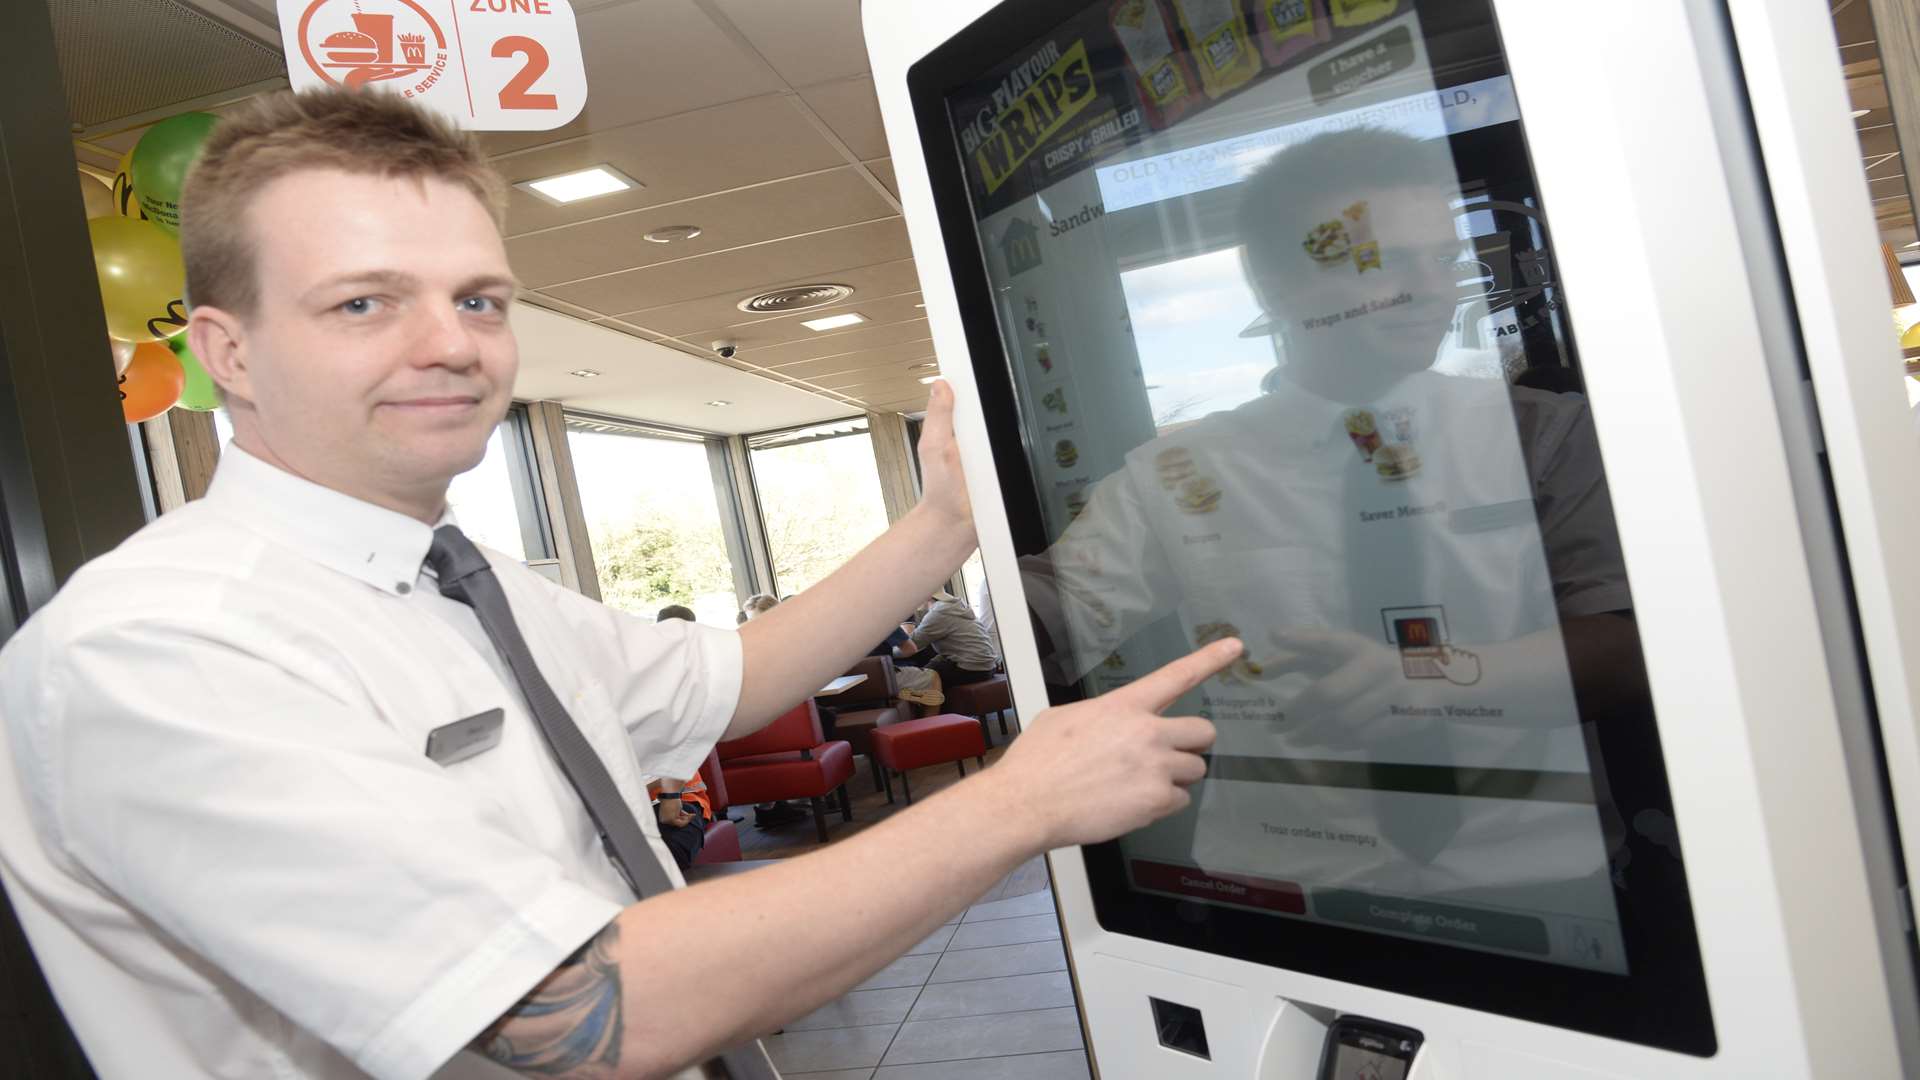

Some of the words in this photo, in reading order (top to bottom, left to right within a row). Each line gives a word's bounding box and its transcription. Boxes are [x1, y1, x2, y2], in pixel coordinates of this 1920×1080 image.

[470, 0, 552, 14] ZONE
[491, 36, 558, 110] 2
[1338, 47, 1376, 73] have
[415, 53, 447, 94] SERVICE
[961, 104, 997, 155] BIG
[991, 40, 1061, 113] FLAVOUR
[977, 58, 1092, 182] WRAPS
[1044, 136, 1084, 169] CRISPY
[1090, 109, 1140, 146] GRILLED
[1113, 161, 1159, 184] OLD
[141, 202, 179, 219] McDona
[1048, 203, 1104, 238] Sandw
[1302, 313, 1341, 330] Wraps
[1343, 302, 1368, 320] and
[1443, 704, 1504, 718] Voucher
[1260, 822, 1289, 836] Your
[1290, 826, 1322, 840] order
[1323, 829, 1336, 841] is
[1337, 833, 1378, 848] empty
[1215, 880, 1248, 897] Order
[1434, 915, 1480, 933] Order
